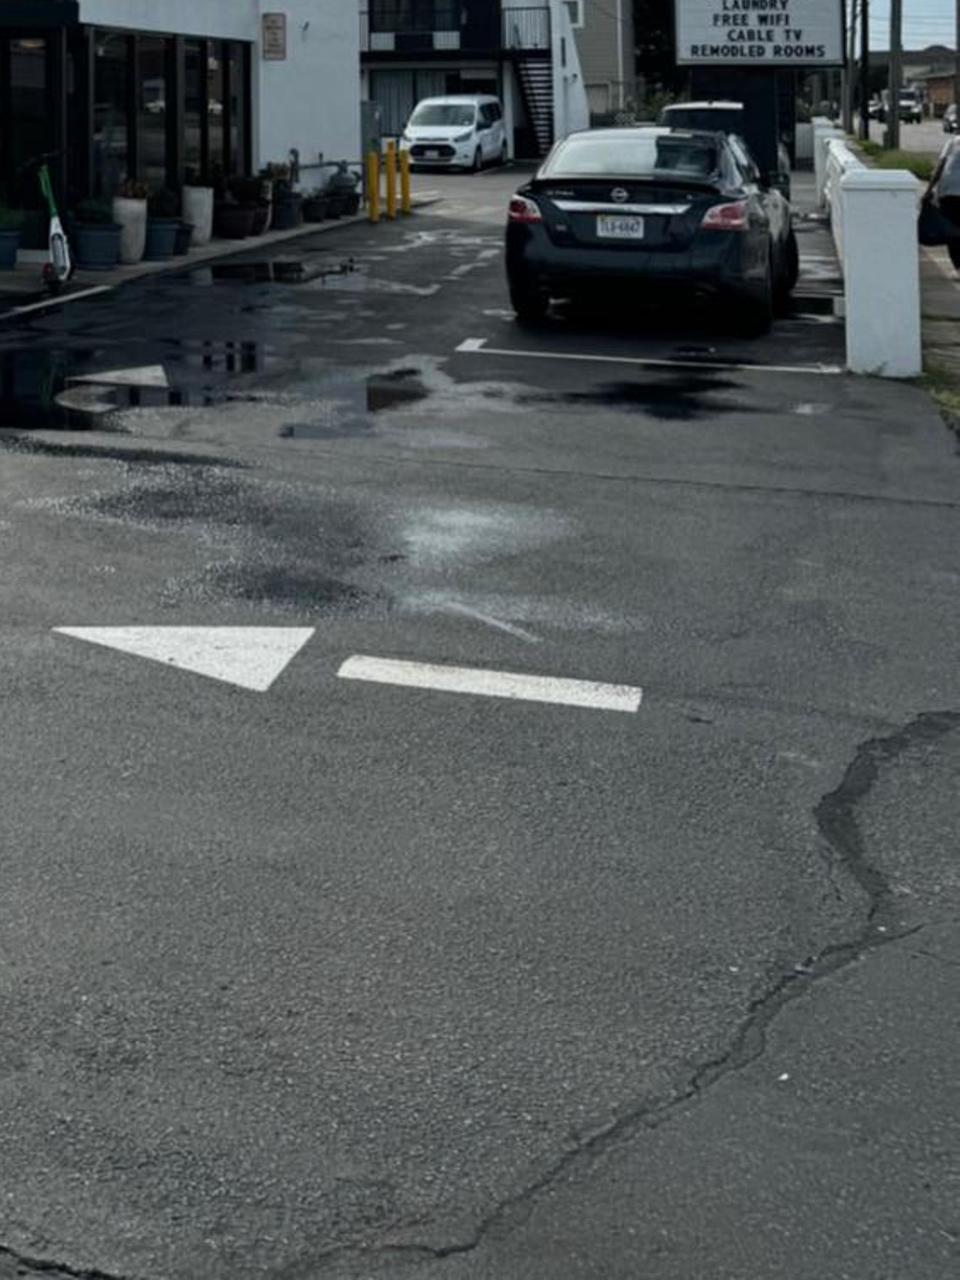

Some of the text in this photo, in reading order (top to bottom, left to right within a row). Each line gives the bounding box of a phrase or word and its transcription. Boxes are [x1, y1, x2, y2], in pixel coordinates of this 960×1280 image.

[713, 13, 790, 27] FREE WIFI
[727, 29, 803, 42] CABLE TV
[691, 44, 826, 58] REMODLED ROOMS
